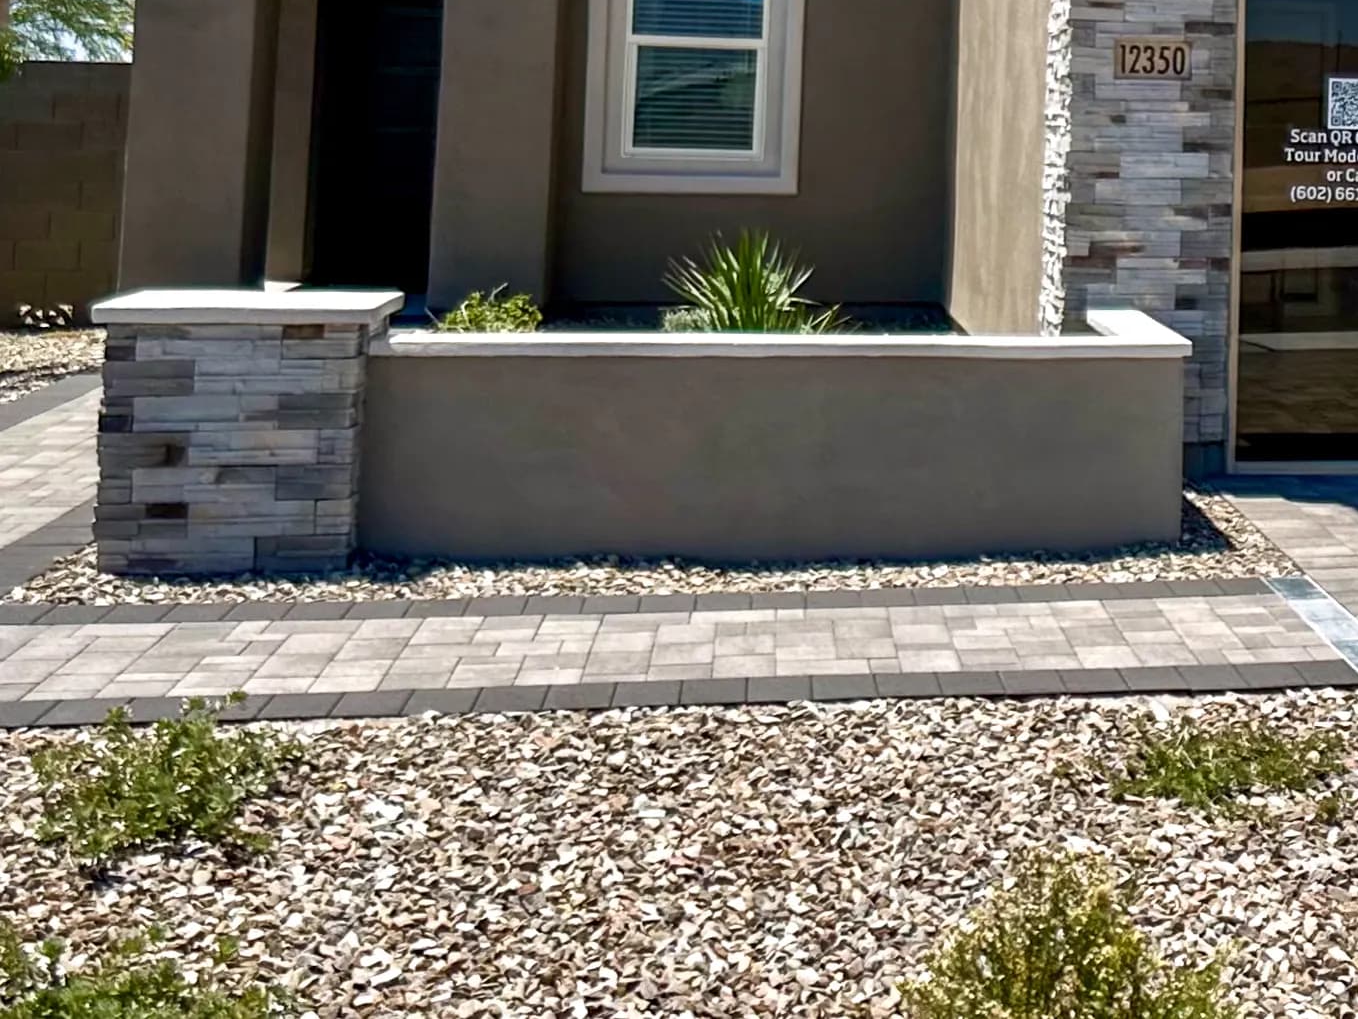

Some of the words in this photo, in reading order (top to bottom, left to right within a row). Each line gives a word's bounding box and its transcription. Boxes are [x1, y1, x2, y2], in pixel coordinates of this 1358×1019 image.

[1120, 45, 1185, 75] 12350
[1290, 129, 1327, 144] Scan
[1330, 130, 1352, 146] QR
[1284, 147, 1321, 162] Tour
[1327, 170, 1343, 182] or
[1290, 186, 1332, 203] (602)
